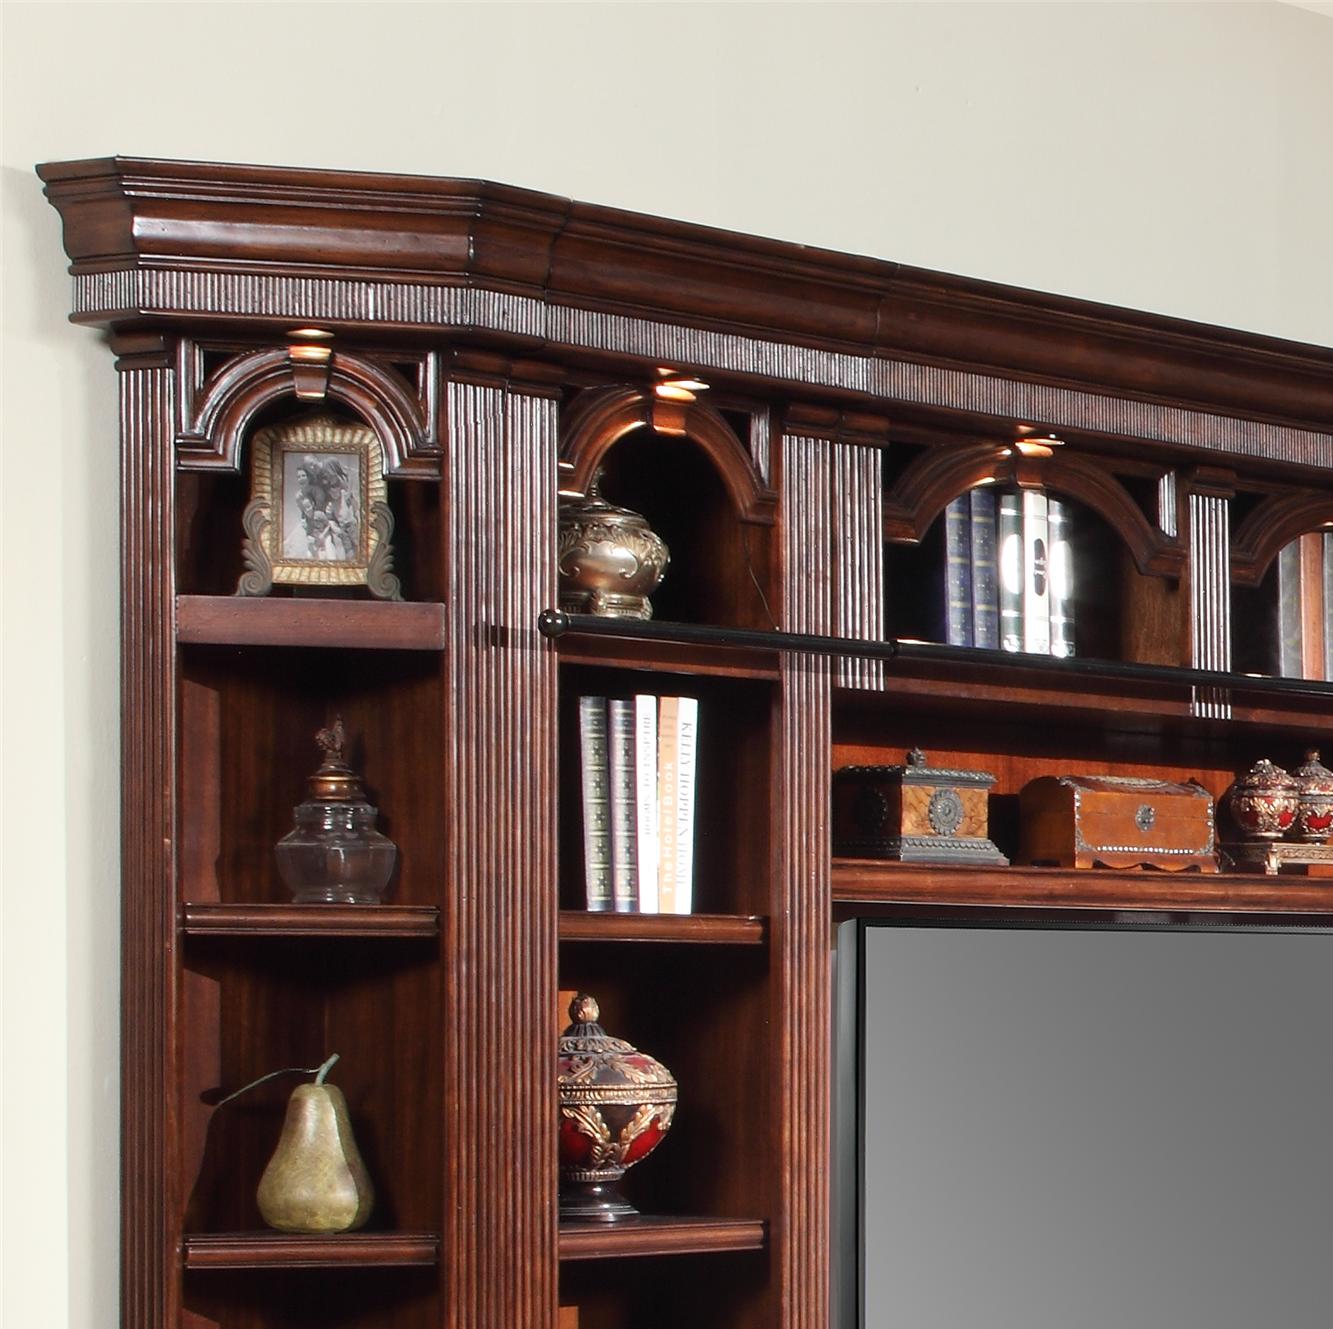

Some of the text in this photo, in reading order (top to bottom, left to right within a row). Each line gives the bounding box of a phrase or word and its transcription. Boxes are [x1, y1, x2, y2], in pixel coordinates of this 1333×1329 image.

[680, 721, 693, 767] KELLY
[662, 761, 673, 806] Book
[678, 773, 691, 838] HOPPEN
[662, 809, 673, 858] Hotel
[662, 861, 674, 893] The
